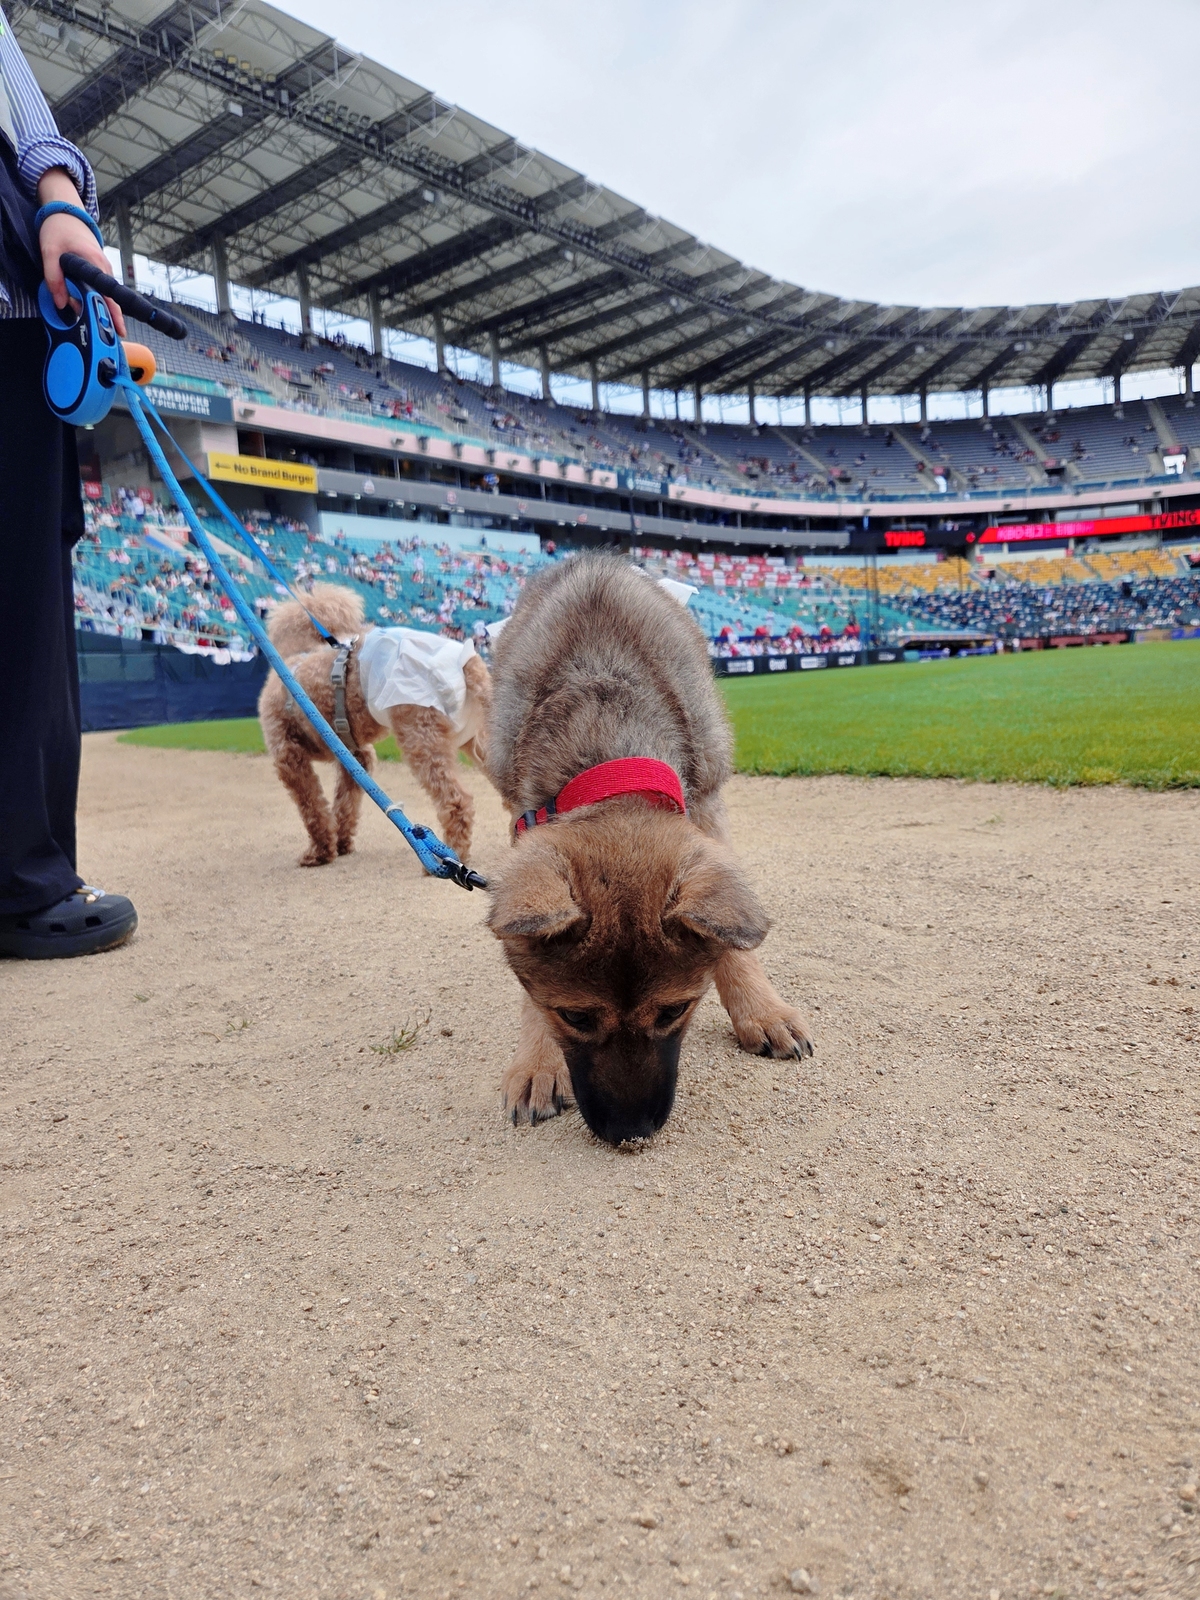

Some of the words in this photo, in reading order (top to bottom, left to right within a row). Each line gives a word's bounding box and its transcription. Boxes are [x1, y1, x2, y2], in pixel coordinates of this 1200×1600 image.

[145, 386, 210, 408] STARBUCKS
[234, 463, 249, 475] No
[250, 466, 280, 480] Brand
[282, 471, 314, 486] Burger
[1149, 510, 1198, 528] TVING
